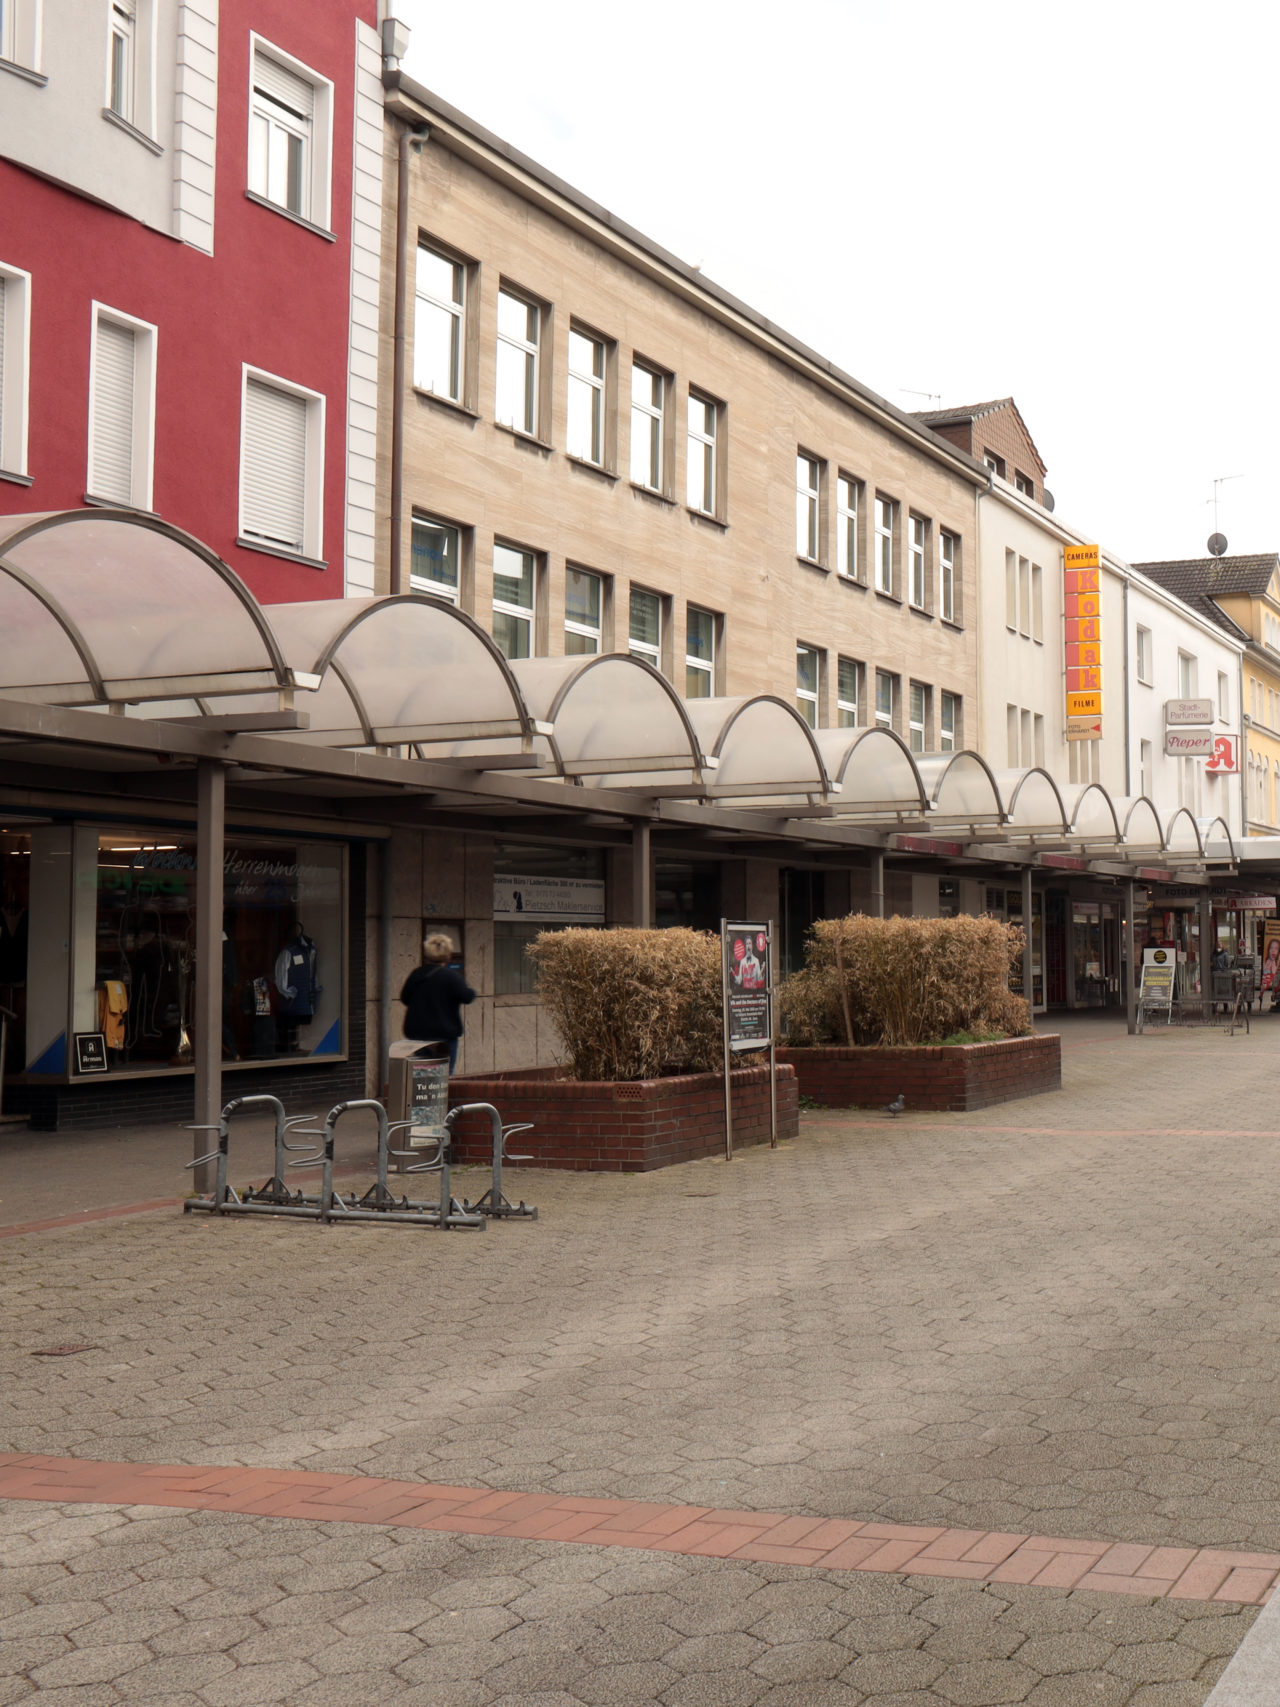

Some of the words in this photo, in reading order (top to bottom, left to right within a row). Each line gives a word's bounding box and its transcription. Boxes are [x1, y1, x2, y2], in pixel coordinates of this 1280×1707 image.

[1066, 551, 1098, 560] CAMERAS
[1079, 570, 1098, 688] Kodak
[1073, 699, 1095, 708] FILME
[1168, 736, 1210, 749] Pieper
[1165, 887, 1187, 896] FOTO
